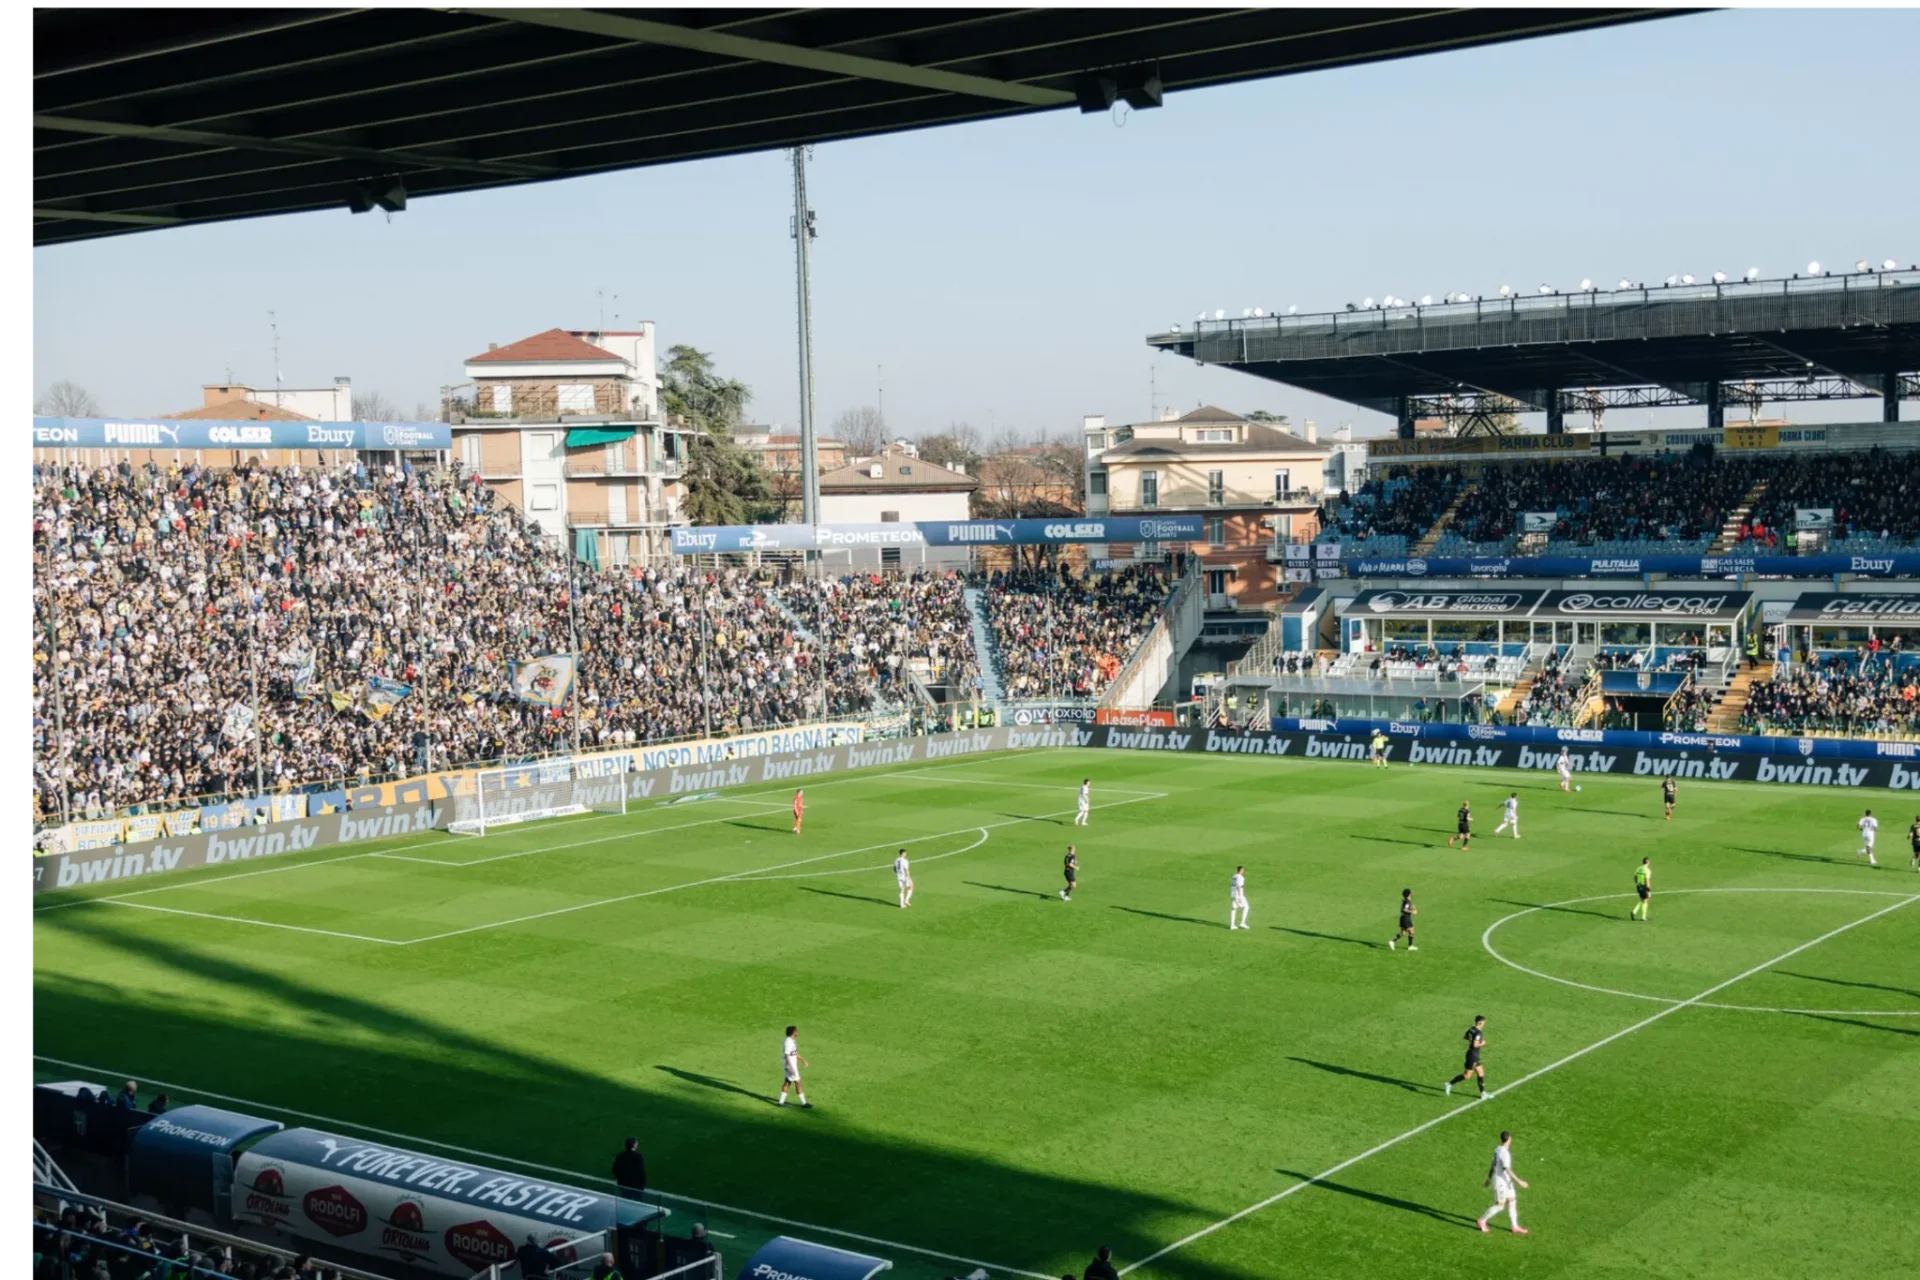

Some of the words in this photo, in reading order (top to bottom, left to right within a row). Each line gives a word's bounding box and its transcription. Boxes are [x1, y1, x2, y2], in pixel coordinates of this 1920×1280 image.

[104, 424, 160, 443] PUMA
[208, 426, 272, 443] COLSER
[307, 426, 355, 446] Ebury
[1500, 437, 1540, 449] PARMA
[1542, 435, 1574, 448] CLUB
[1778, 431, 1802, 442] PARMA
[676, 531, 717, 549] Ebury
[812, 528, 923, 544] PROMETEON
[949, 524, 998, 541] PUMA
[1045, 523, 1105, 538] COLSER
[1592, 559, 1640, 568] PULITALIA
[1718, 565, 1755, 573] ENERGIA
[1851, 557, 1894, 572] Ebury
[1401, 595, 1450, 608] AB
[1456, 595, 1508, 603] Global
[1449, 601, 1508, 611] Service
[1593, 594, 1728, 612] callegari
[1822, 599, 1920, 613] Cetila
[1032, 709, 1051, 720] IVY
[1055, 709, 1096, 719] OXFORD
[1105, 713, 1165, 726] LeasePlan
[1299, 720, 1328, 731] PUMA
[1390, 722, 1421, 736] Ebury
[1557, 729, 1604, 741] COLSER
[926, 731, 992, 758] bwin.tv
[1007, 728, 1093, 748] bwin.tv
[1107, 727, 1192, 751] bwin.tv
[1205, 730, 1292, 755] bwin.tv
[1305, 735, 1394, 760] bwin.v
[644, 745, 691, 771] NORD
[848, 742, 915, 769] bwin.tv
[1409, 740, 1501, 766] bwin.tv
[1517, 745, 1617, 773] bwn.tv
[1877, 743, 1914, 756] PUMA
[762, 752, 835, 780] bwin.tv
[1633, 751, 1739, 780] bwin.tv
[1756, 757, 1869, 787] bwin.tv
[670, 764, 749, 793] bwin.tv
[338, 806, 444, 842] bwin.tv
[206, 824, 319, 863] bwin.tv
[57, 844, 184, 888] bwin.tv
[149, 1119, 232, 1146] PROMETEON
[336, 1147, 480, 1194] FOREVER.
[467, 1175, 599, 1222] FASTER.
[246, 1193, 290, 1216] ORTOLINA
[309, 1198, 360, 1223] RODOLFI
[383, 1227, 430, 1251] ORTOLINA
[452, 1233, 508, 1260] RODOLFI
[753, 1263, 816, 1280] PROM
